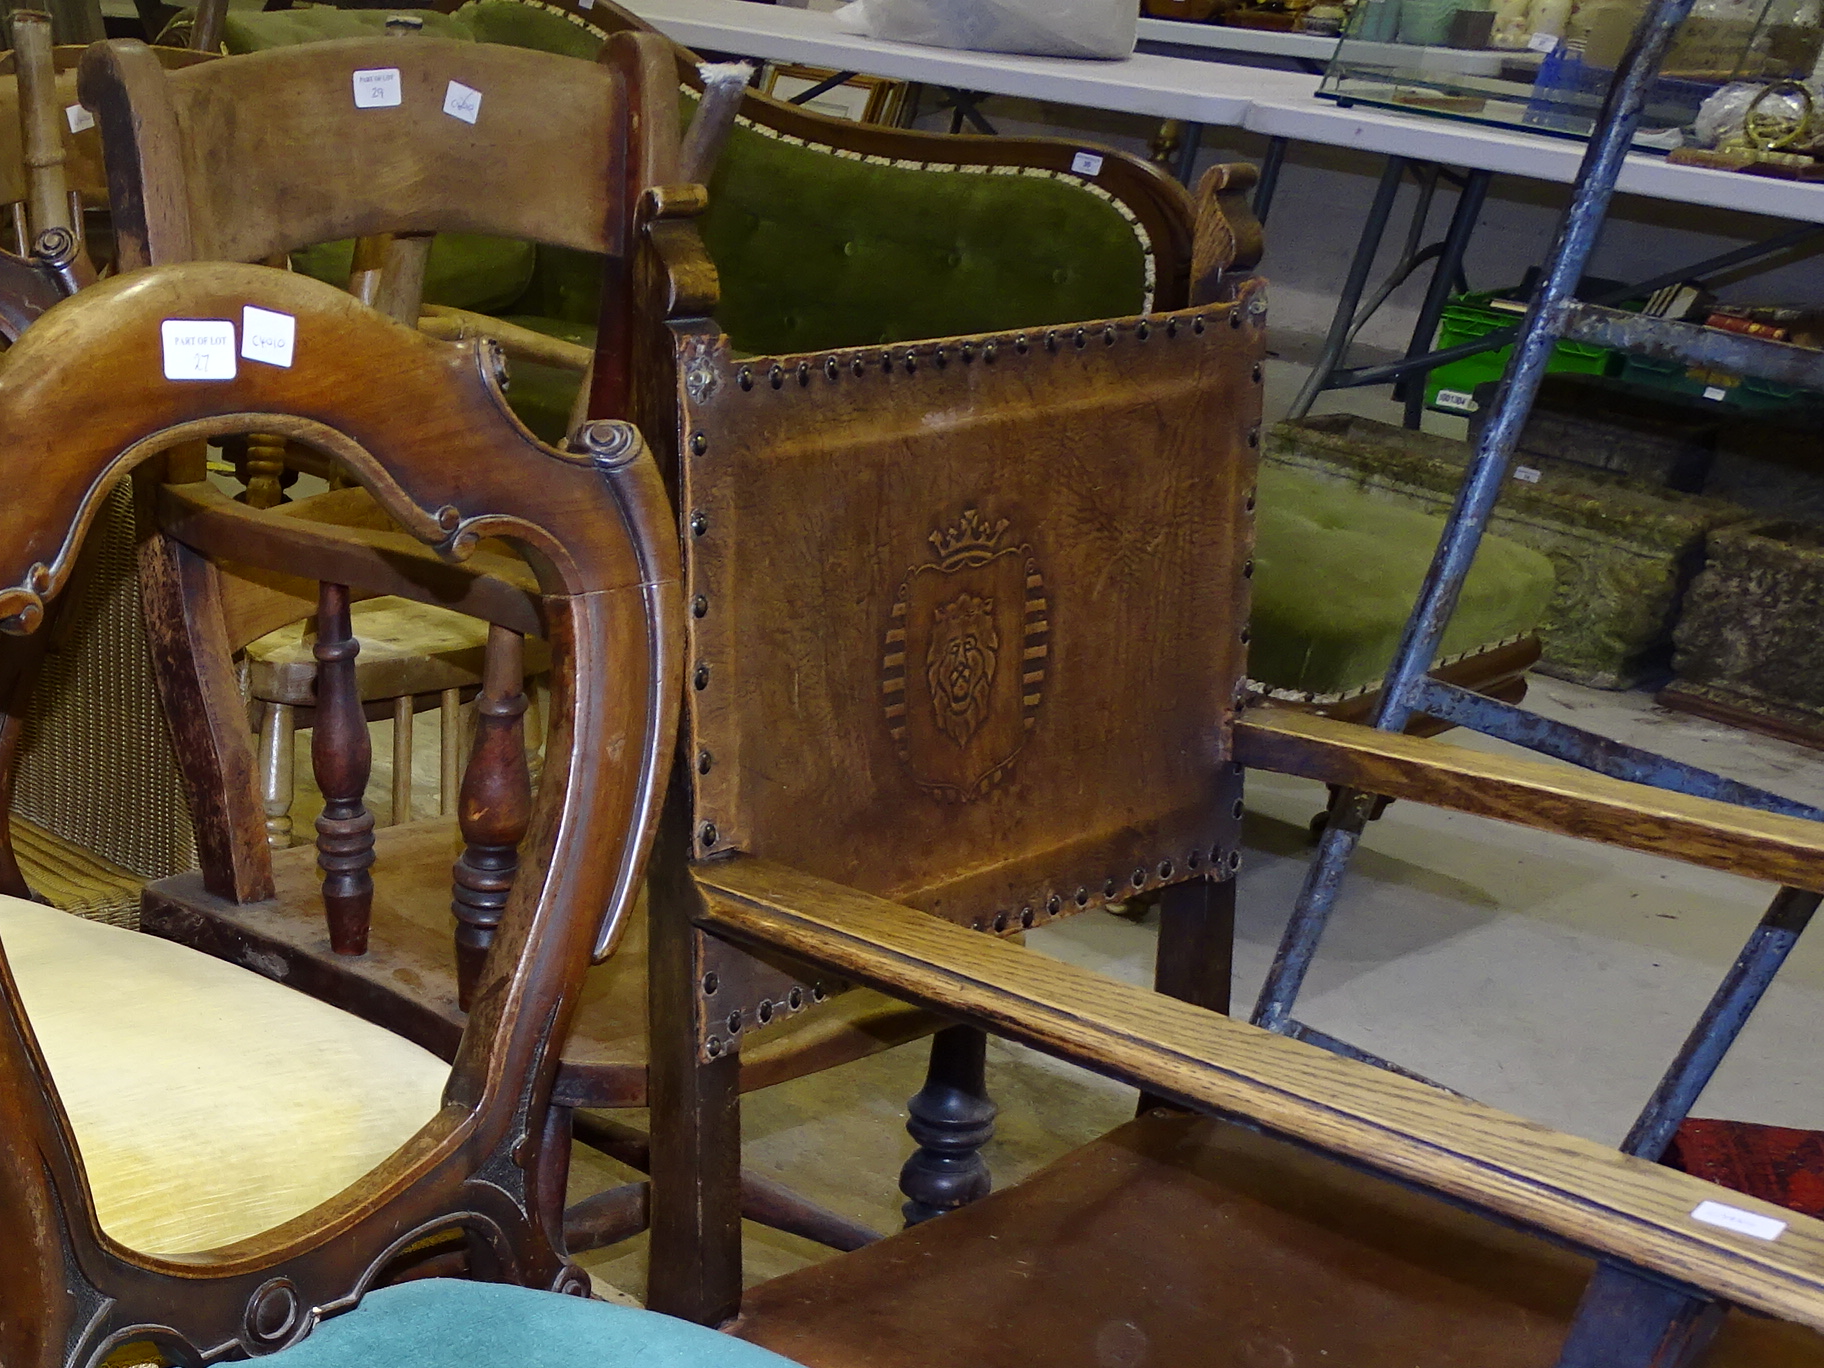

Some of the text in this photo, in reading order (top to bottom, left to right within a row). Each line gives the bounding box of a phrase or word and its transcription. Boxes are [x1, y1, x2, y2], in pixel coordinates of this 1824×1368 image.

[174, 335, 228, 346] PART OF LOT
[194, 352, 210, 373] 27
